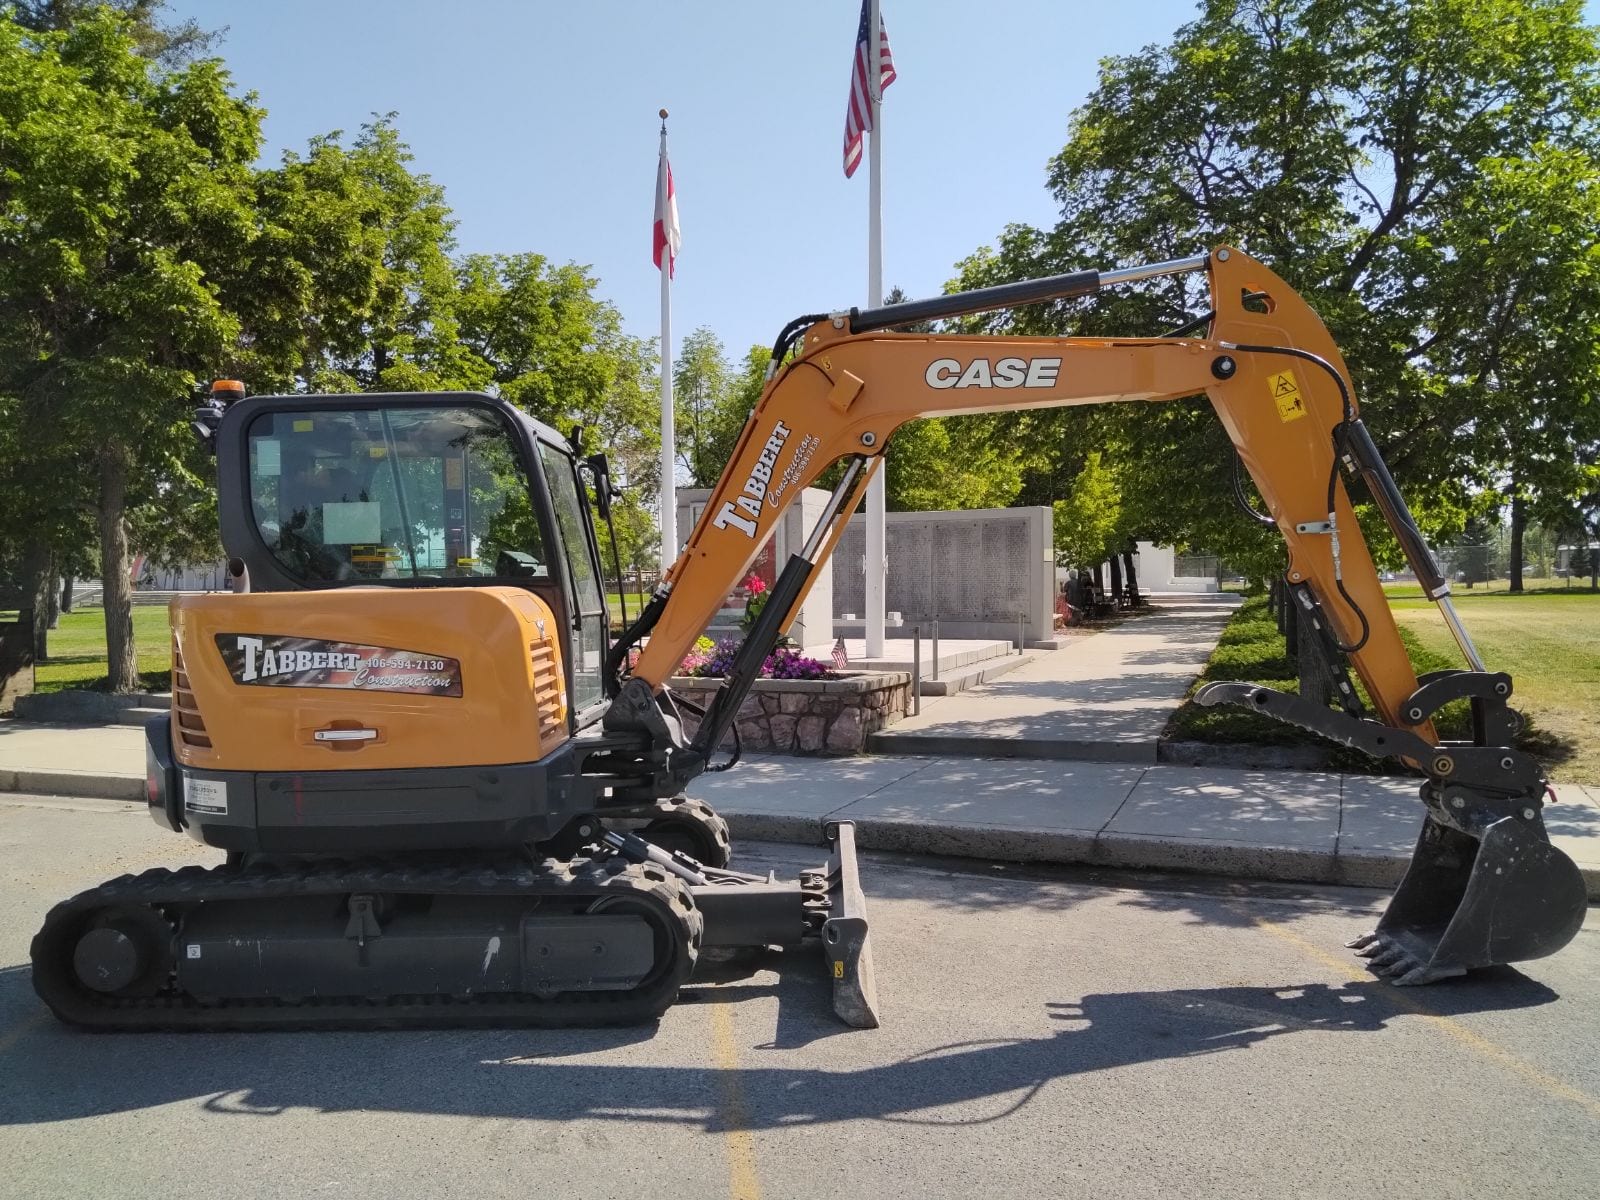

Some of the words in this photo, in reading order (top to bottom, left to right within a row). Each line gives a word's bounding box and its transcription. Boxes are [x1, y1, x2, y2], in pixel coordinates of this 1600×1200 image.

[924, 357, 1063, 389] CASE
[712, 420, 791, 538] TABBERT
[767, 433, 812, 508] Construction
[790, 437, 820, 485] 406-594-7130
[237, 636, 361, 683] TABBERT
[353, 668, 451, 687] Construction
[366, 659, 444, 671] 406-594-7130
